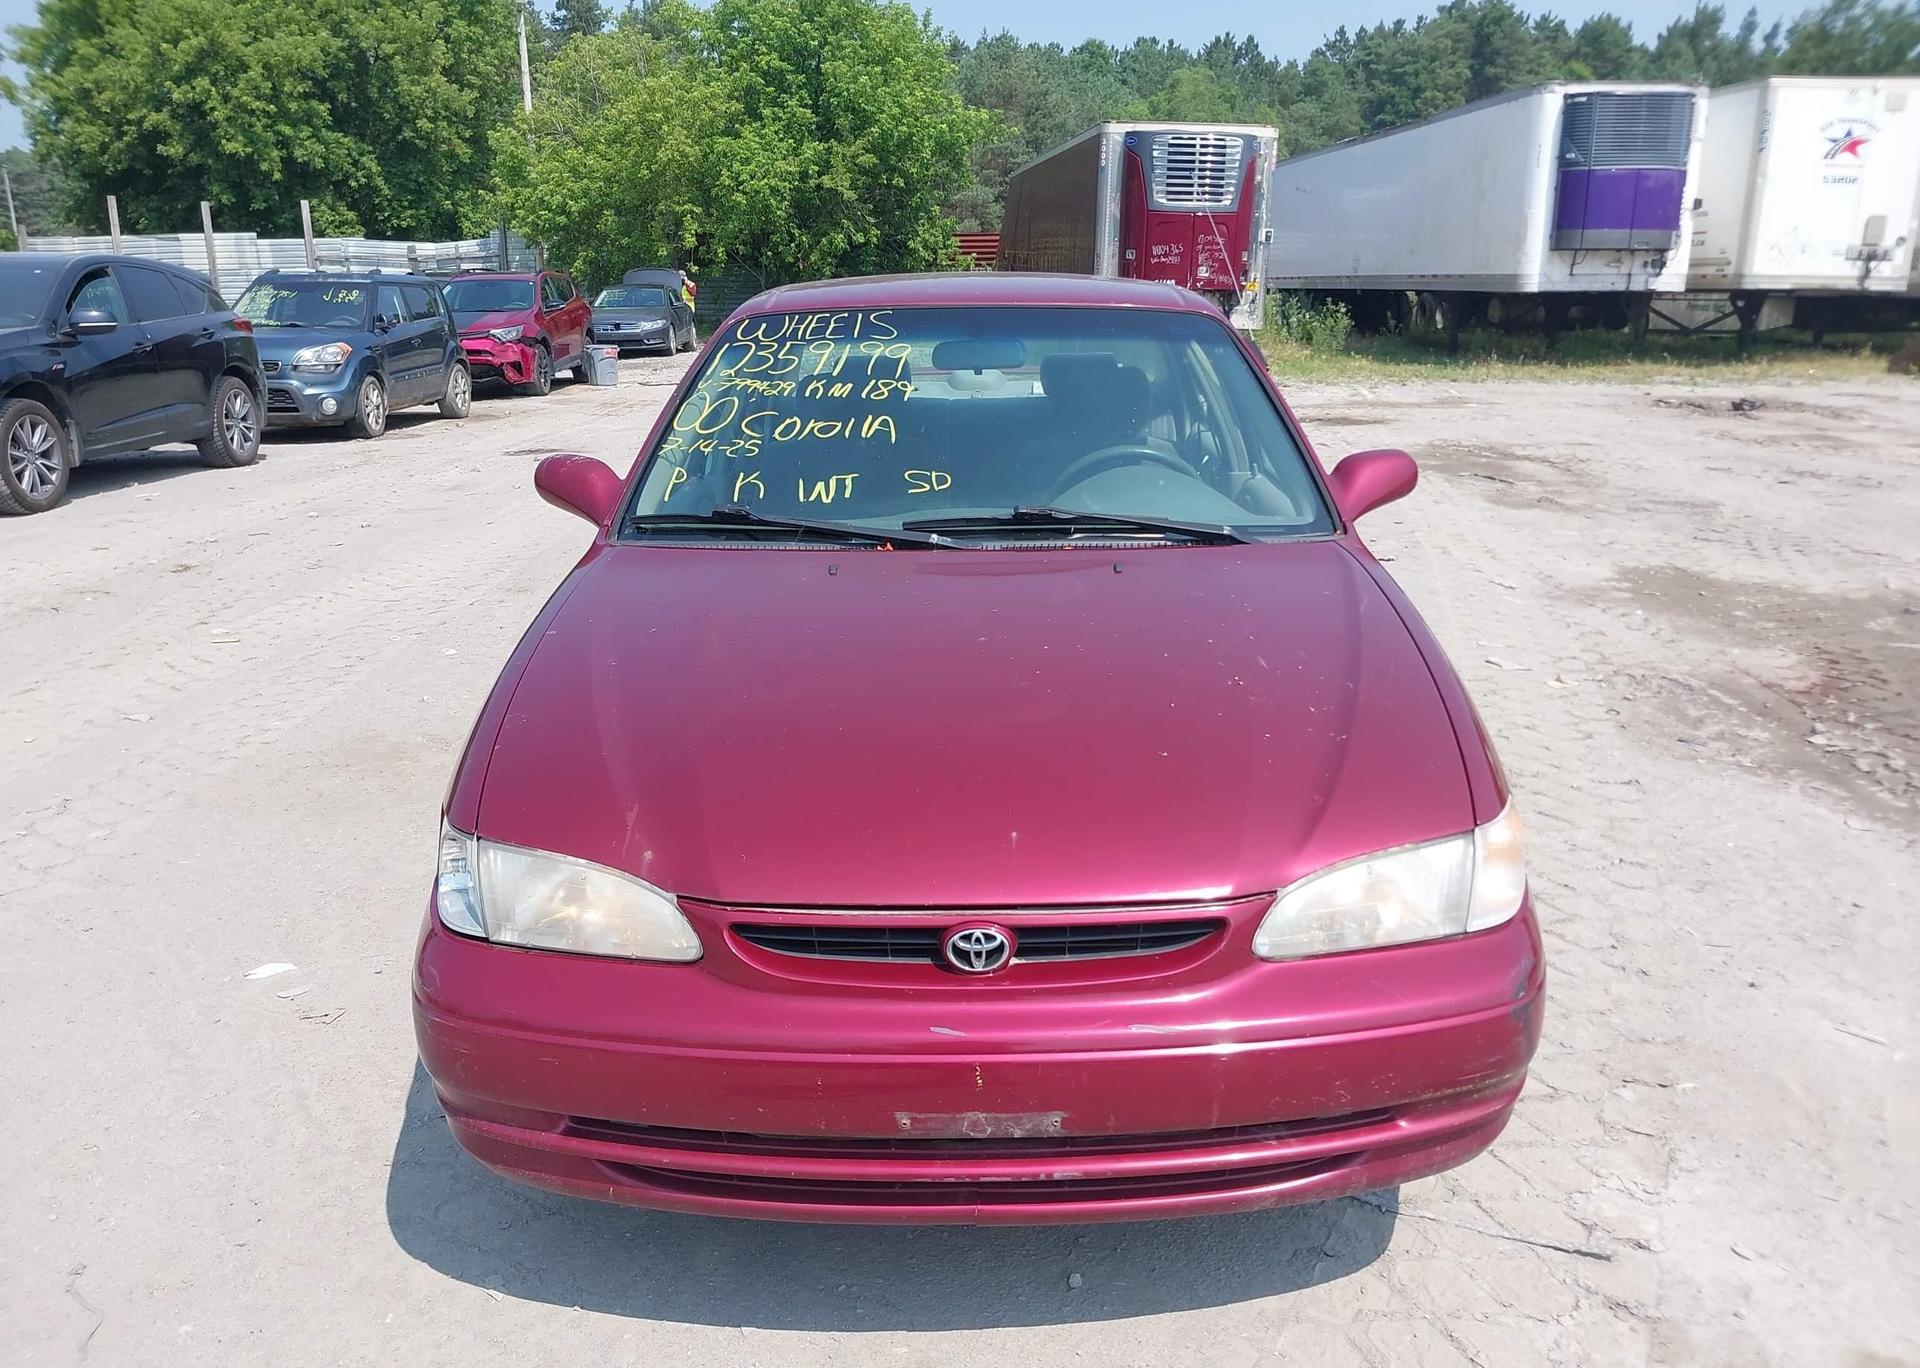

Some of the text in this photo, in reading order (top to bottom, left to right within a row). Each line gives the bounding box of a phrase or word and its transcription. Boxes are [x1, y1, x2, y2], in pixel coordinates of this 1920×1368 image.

[705, 340, 912, 379] 12359199
[804, 379, 853, 399] KM
[663, 466, 952, 504] P K INT SD
